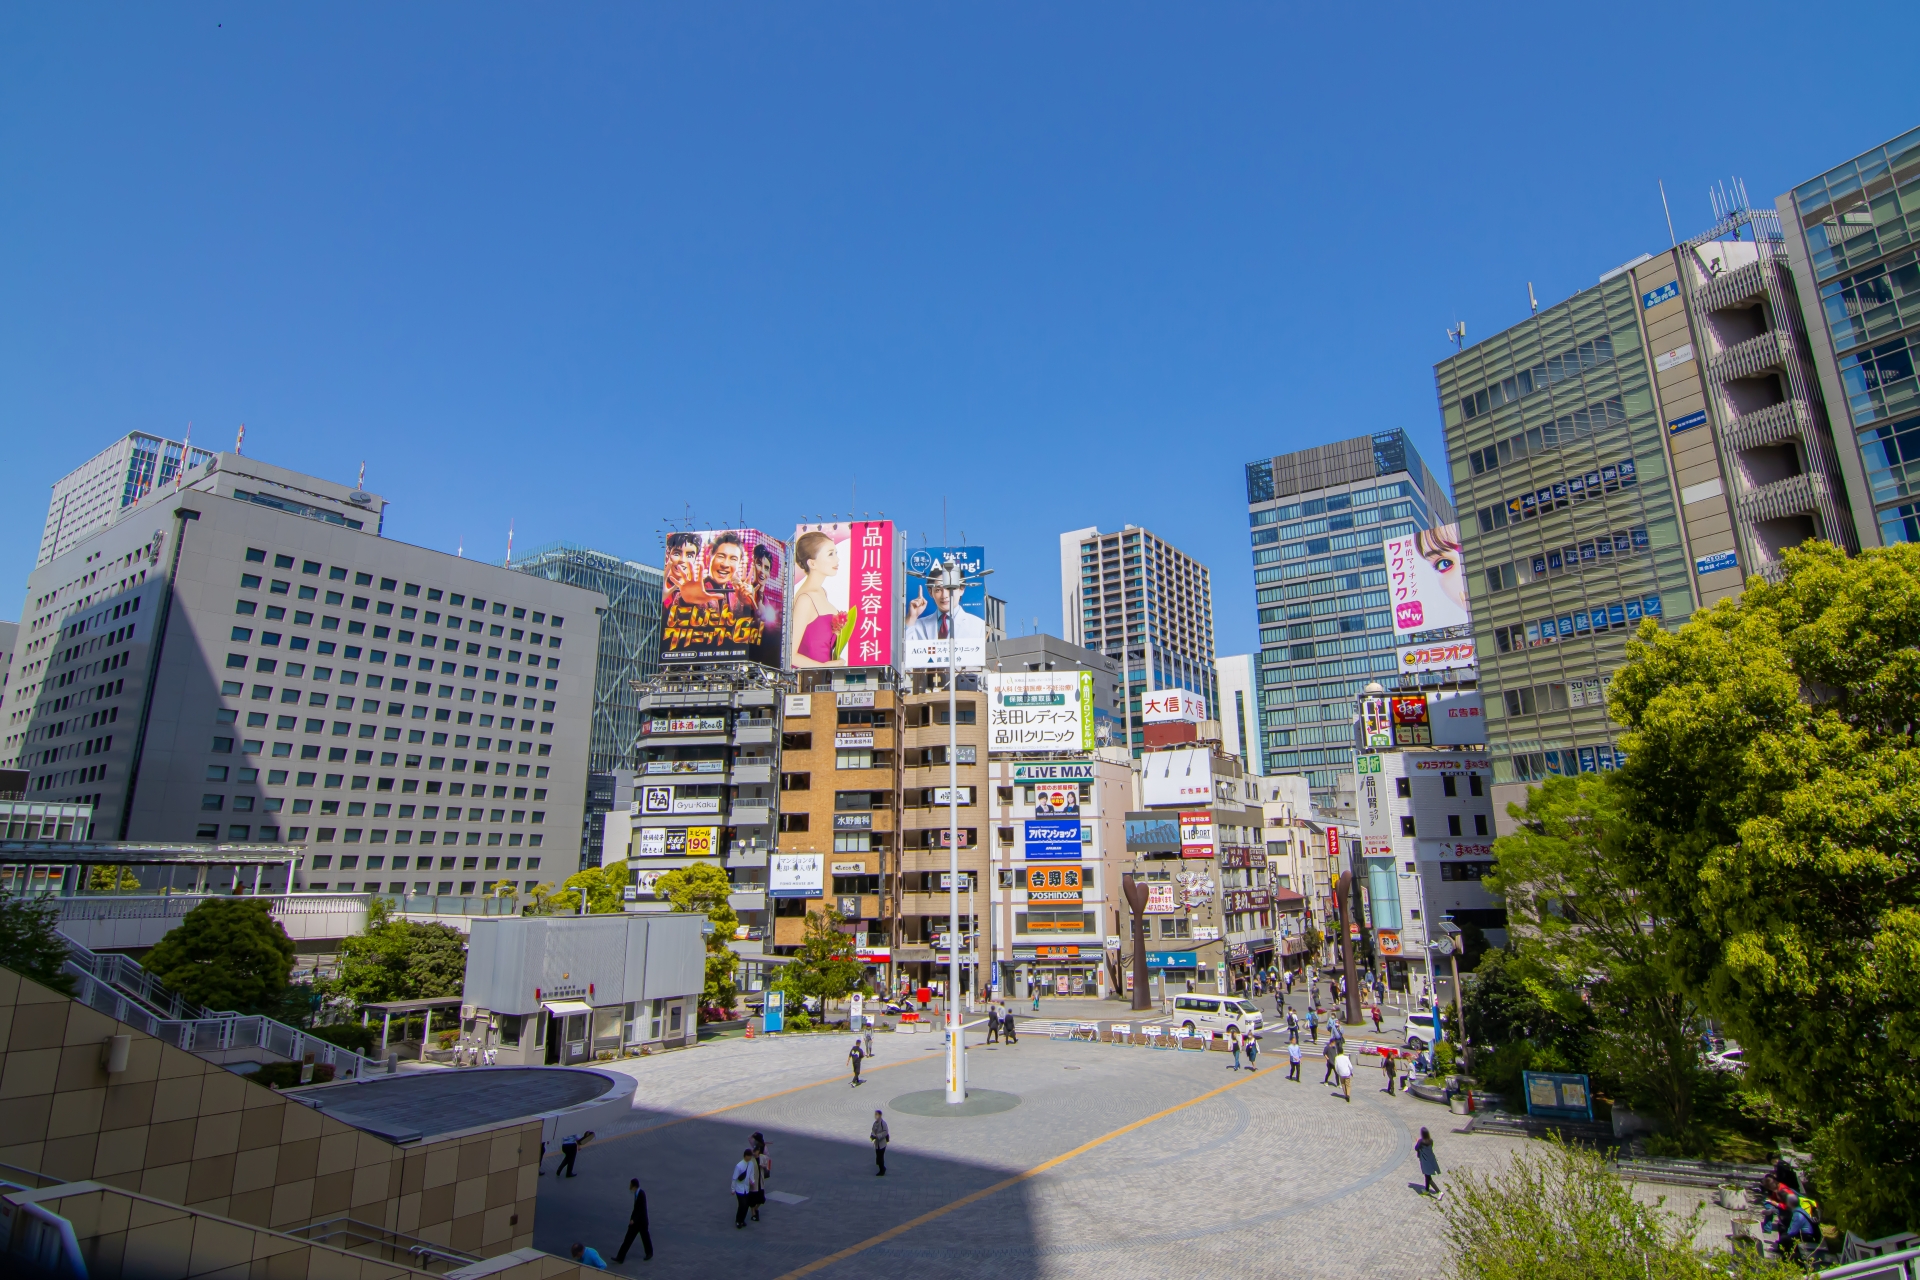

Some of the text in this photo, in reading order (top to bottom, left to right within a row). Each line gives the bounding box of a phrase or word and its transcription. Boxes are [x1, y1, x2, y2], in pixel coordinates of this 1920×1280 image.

[1524, 460, 1635, 507] 住友不動産販売
[576, 554, 617, 572] SONY
[943, 551, 968, 560] なんでも
[1716, 558, 1735, 568] イーオン
[1388, 541, 1408, 601] ワクワク
[1404, 538, 1419, 599] 劇的マッチング
[860, 526, 883, 662] 品川美容外科
[667, 604, 737, 628] にしたん
[1543, 596, 1663, 638] 英会話イーオン
[911, 646, 927, 655] AGA
[936, 645, 980, 654] スキクリニック
[1415, 644, 1475, 665] カラオケ
[1145, 697, 1204, 719] 大信 大信
[1397, 700, 1423, 716] すき家
[992, 709, 1078, 725] 浅田レディース
[671, 720, 723, 731] 日本酒が飲める店
[995, 729, 1075, 744] 品川クリニック
[1060, 766, 1093, 778] MAX
[1358, 757, 1380, 773] 透析
[1422, 760, 1454, 769] カラオケ
[1180, 787, 1209, 795] 広告募集
[650, 792, 667, 807] 牛角
[676, 801, 717, 810] Gyu-Kaku
[837, 816, 870, 825] 水野歯科
[1028, 828, 1077, 839] アパマンショップ
[1330, 829, 1338, 853] カラオケ
[688, 838, 709, 849] 190
[1364, 846, 1378, 855] 入口
[1031, 870, 1079, 888] 吉野家
[1032, 891, 1080, 899] YOSHINOYA
